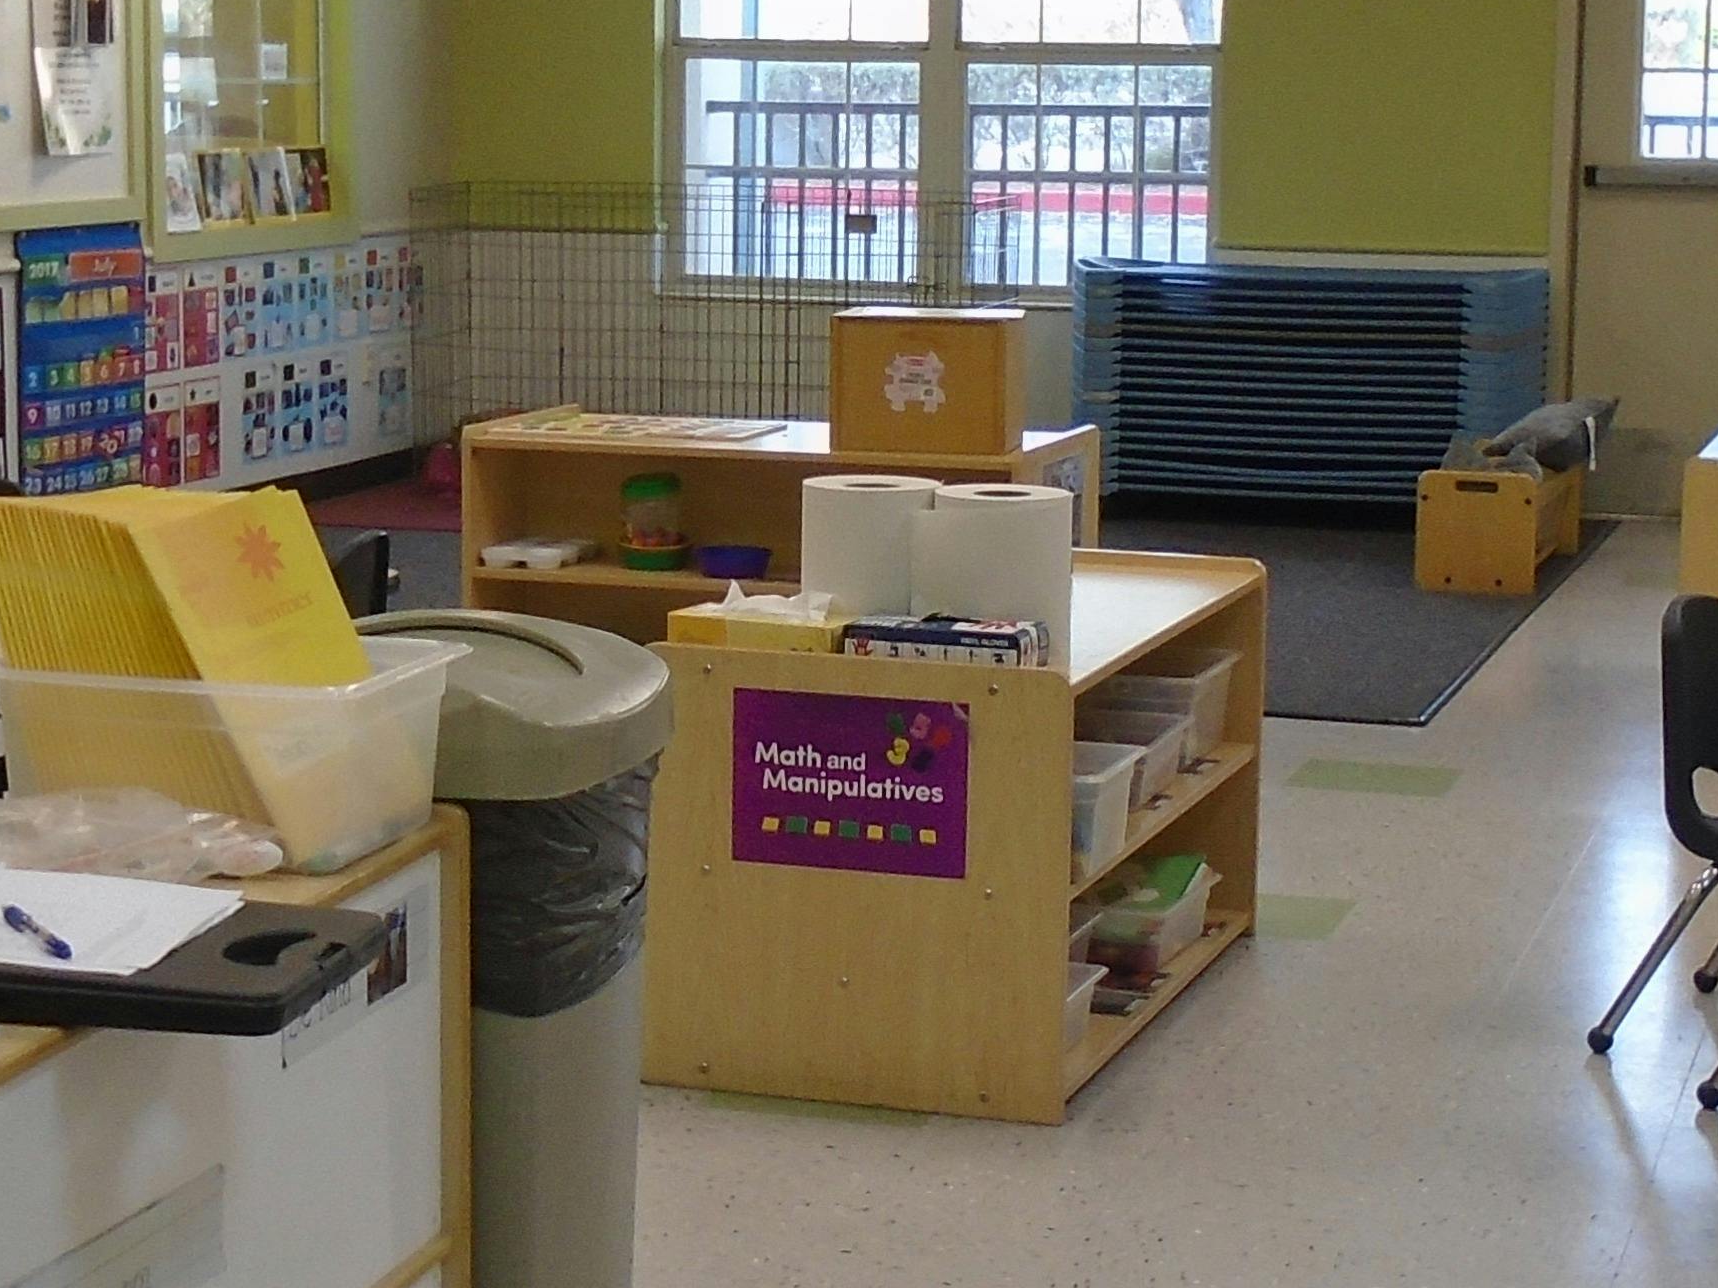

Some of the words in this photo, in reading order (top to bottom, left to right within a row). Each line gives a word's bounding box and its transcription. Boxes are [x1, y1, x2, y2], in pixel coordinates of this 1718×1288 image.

[28, 261, 60, 279] 2017
[93, 256, 117, 277] July
[28, 372, 38, 387] 2
[50, 370, 59, 385] 3
[67, 367, 75, 383] 4
[100, 363, 109, 378] 6
[118, 362, 125, 376] 7
[27, 408, 38, 424] 9
[46, 405, 61, 421] 10
[66, 403, 76, 418] 11
[80, 401, 92, 416] 12
[25, 477, 42, 494] 23
[46, 476, 62, 492] 24
[754, 741, 822, 769] Math
[826, 752, 866, 772] and
[763, 769, 945, 804] Manipulatives
